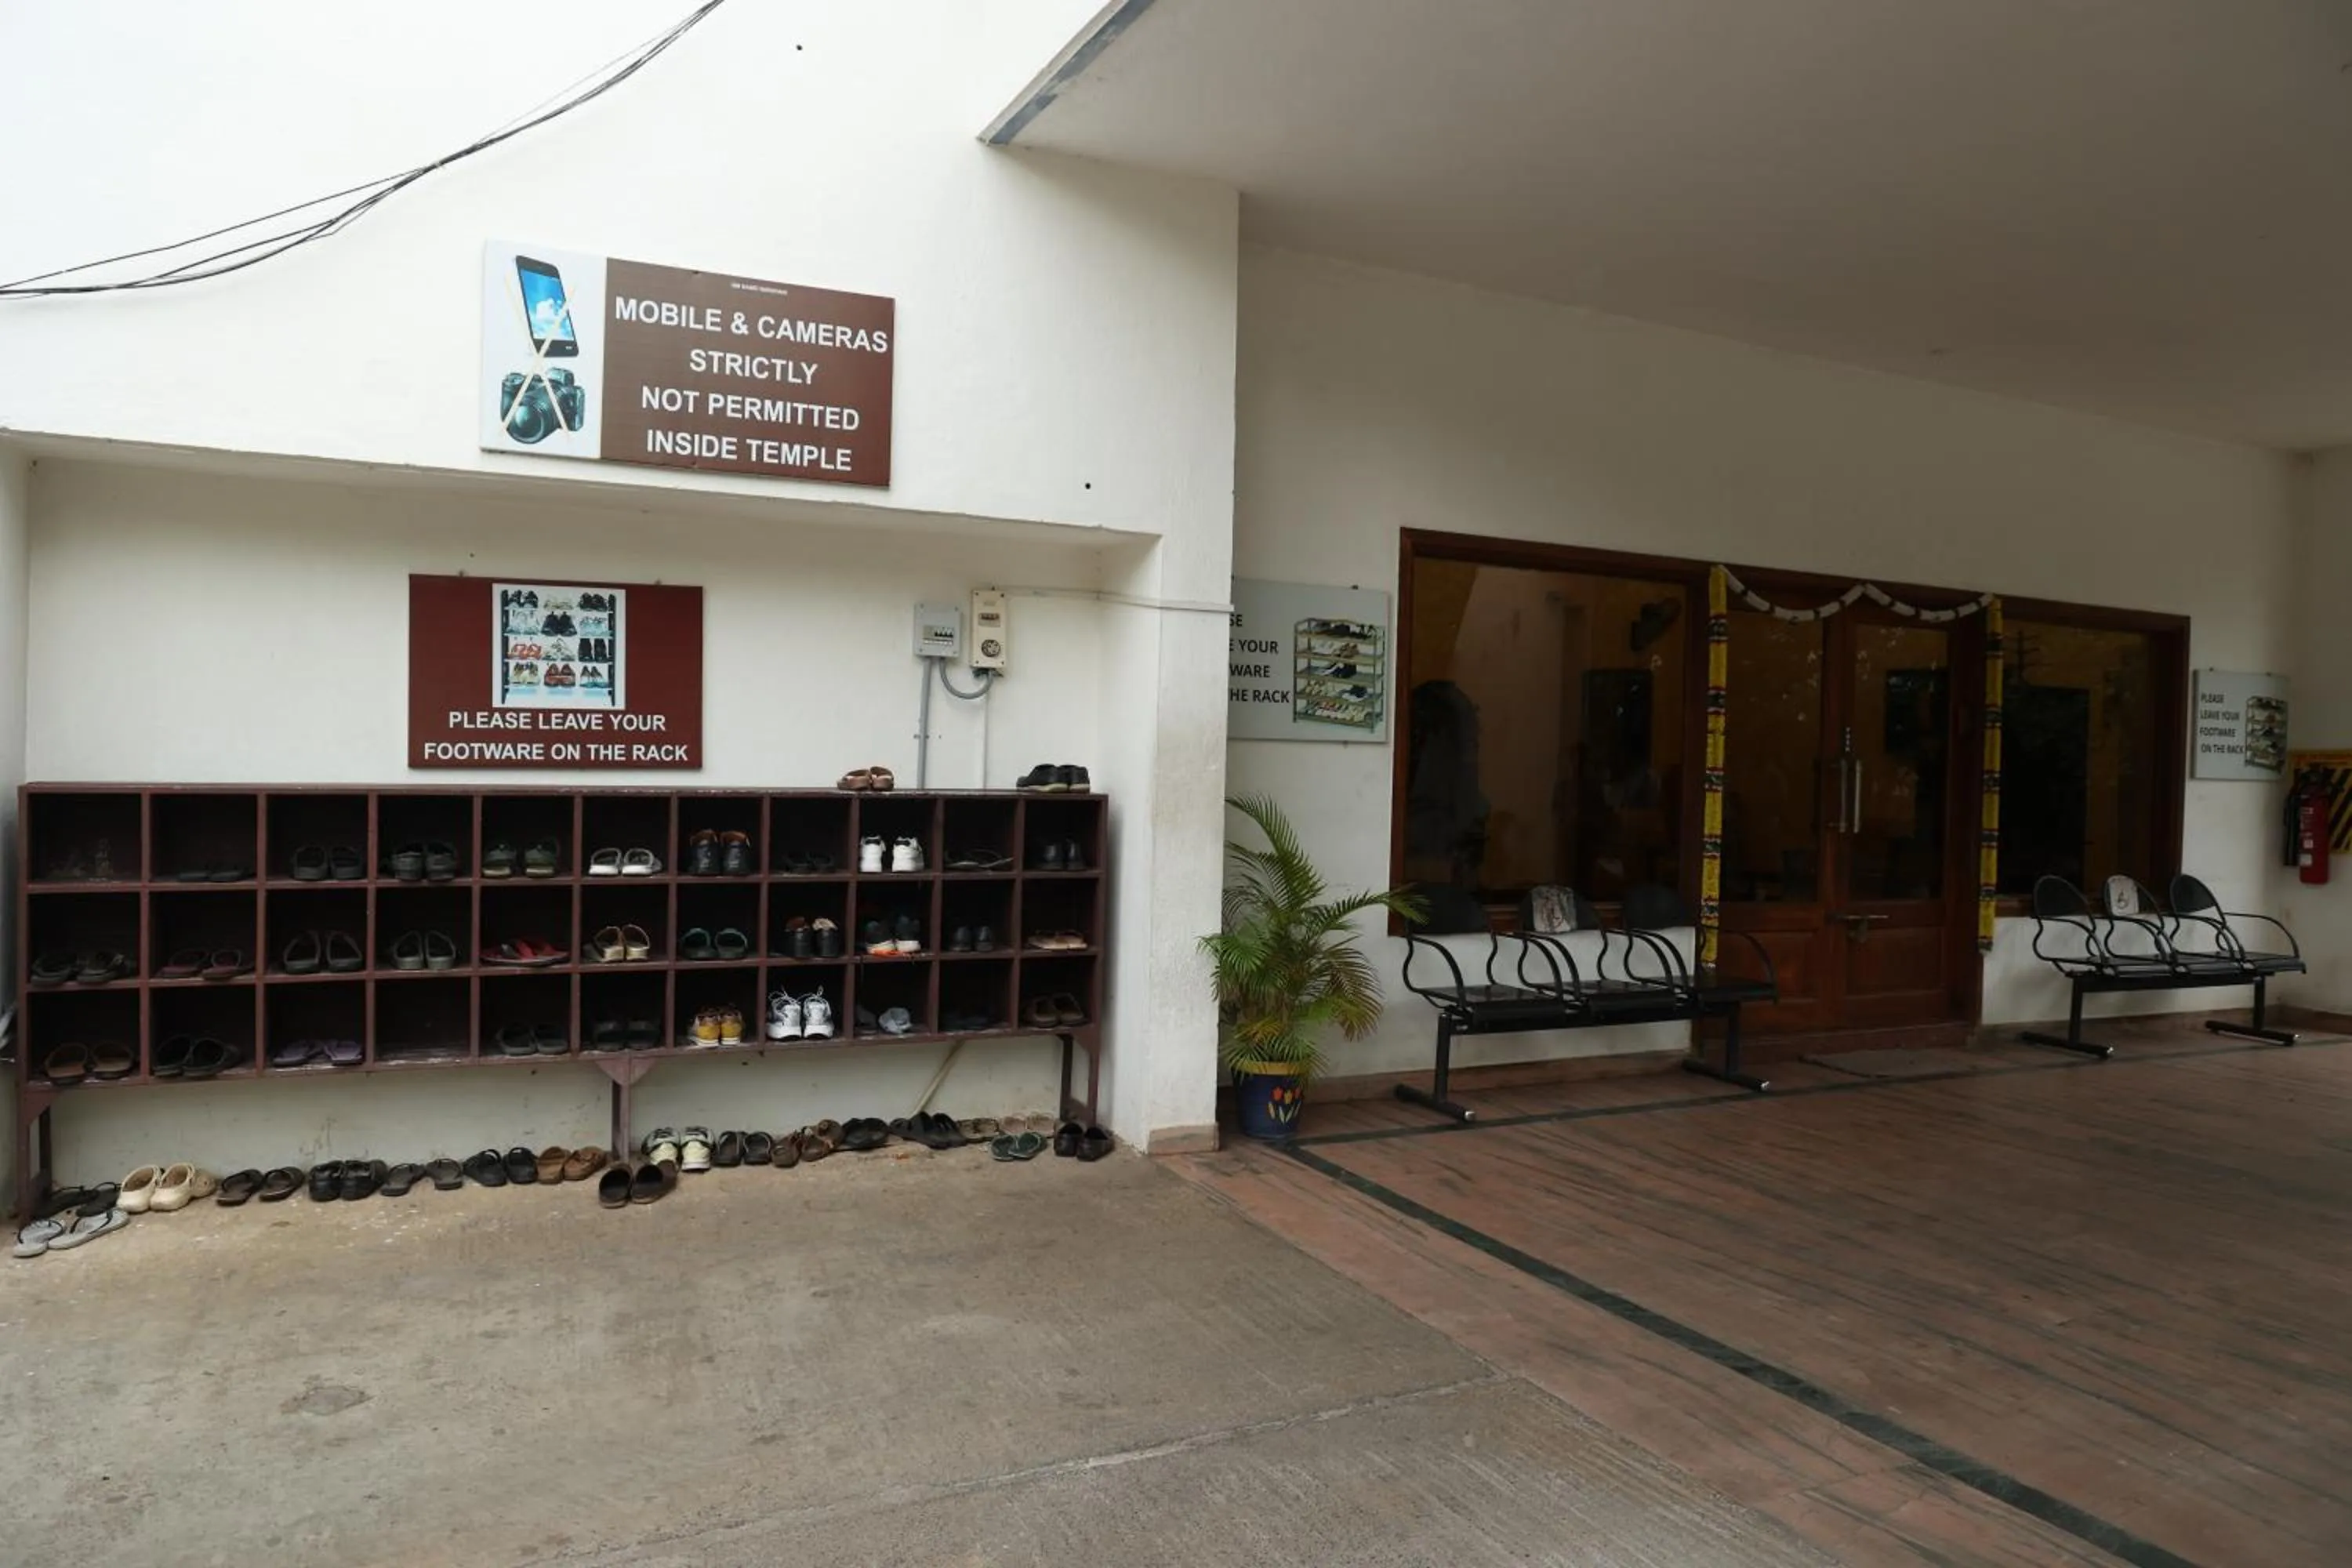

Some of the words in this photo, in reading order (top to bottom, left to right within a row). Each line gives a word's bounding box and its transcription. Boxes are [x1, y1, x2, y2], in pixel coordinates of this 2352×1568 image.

[615, 296, 722, 332] MOBILE
[731, 311, 749, 336] &
[757, 316, 888, 353] CAMERAS
[689, 349, 818, 385] STRICTLY
[641, 386, 699, 413] NOT
[708, 393, 860, 431] PERMITTED
[646, 429, 738, 460] INSIDE
[746, 437, 853, 472] TEMPLE
[1238, 639, 1279, 655] YOUR
[1229, 663, 1272, 678] WARE
[1252, 689, 1290, 703] RACK
[2201, 693, 2225, 704] PLEASE
[449, 711, 532, 730] PLEASE
[538, 713, 603, 730] LEAVE
[610, 714, 666, 731] YOUR
[2200, 710, 2220, 720] LEAVE
[2221, 711, 2240, 720] YOUR
[424, 742, 545, 760] FOOTWARE
[551, 743, 581, 760] ON
[586, 744, 626, 760] THE
[632, 744, 688, 761] RACK
[2201, 743, 2212, 753] ON
[2213, 744, 2226, 753] THE
[2227, 745, 2245, 754] RACK
